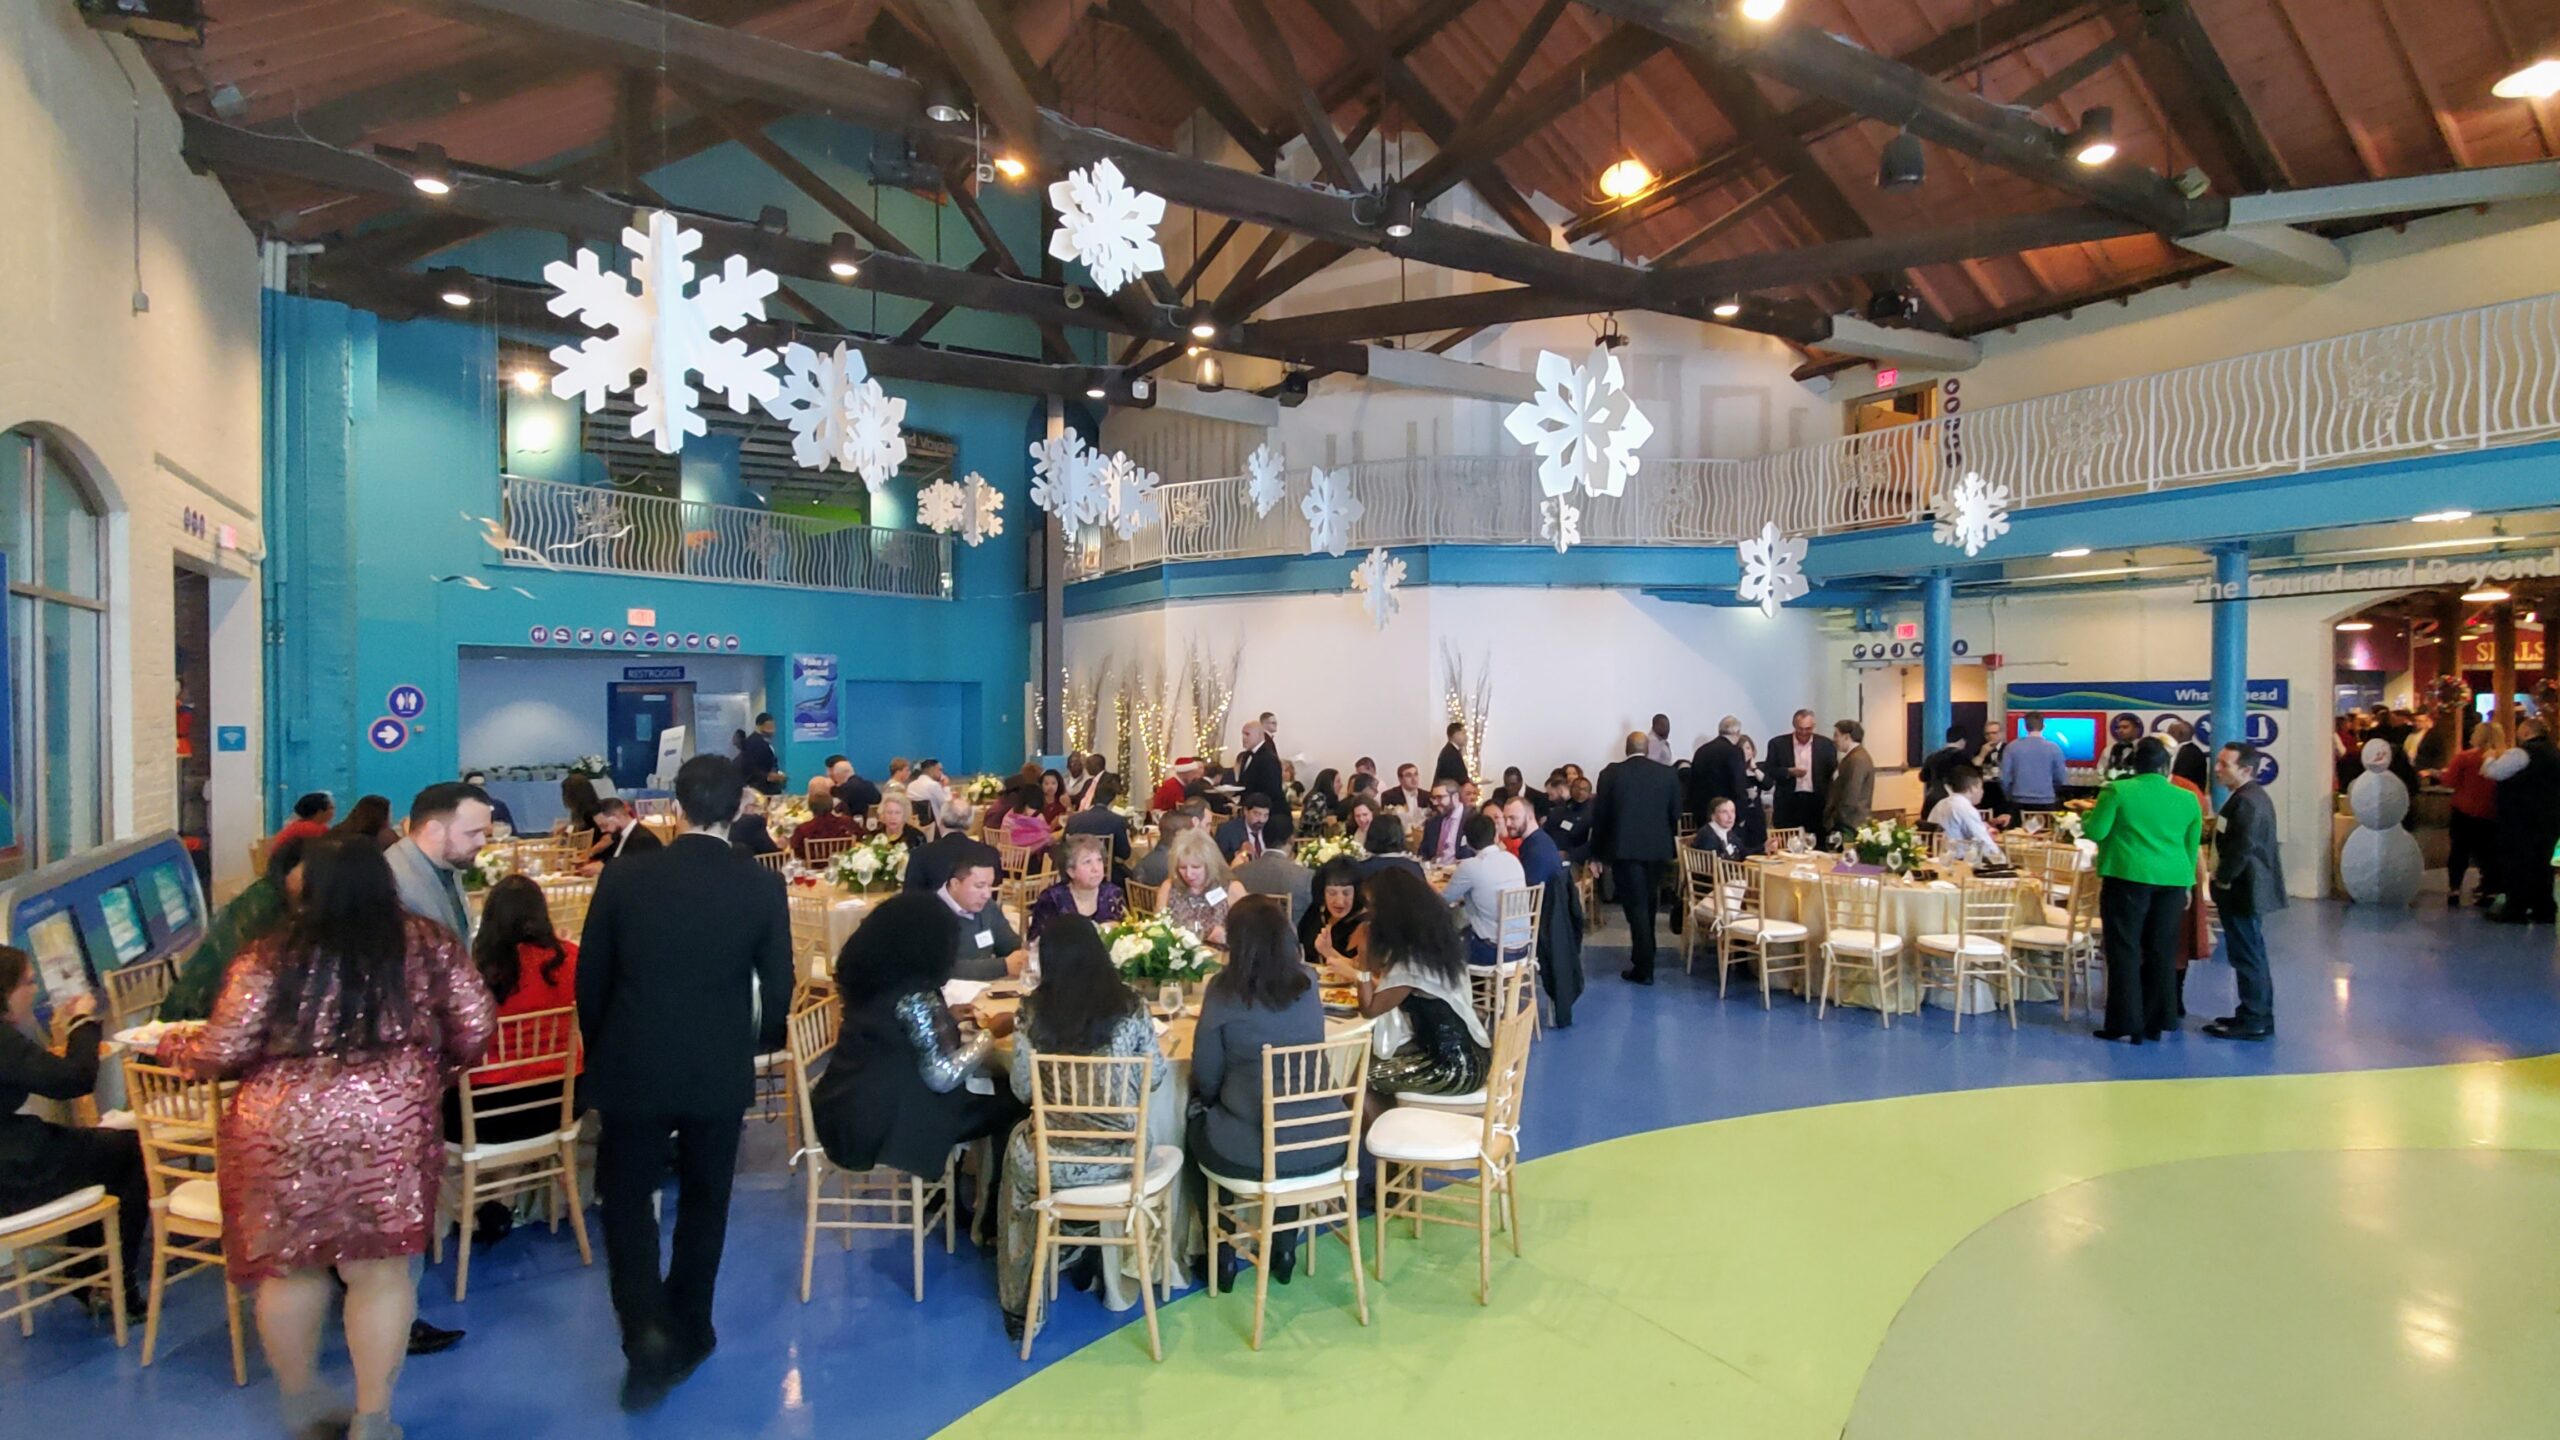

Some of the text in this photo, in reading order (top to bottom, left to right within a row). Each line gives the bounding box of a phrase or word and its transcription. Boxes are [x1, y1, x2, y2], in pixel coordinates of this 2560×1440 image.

[2186, 547, 2560, 600] The Sound and Beyond
[2476, 641, 2544, 662] SLS
[628, 668, 682, 679] RESTROOMS
